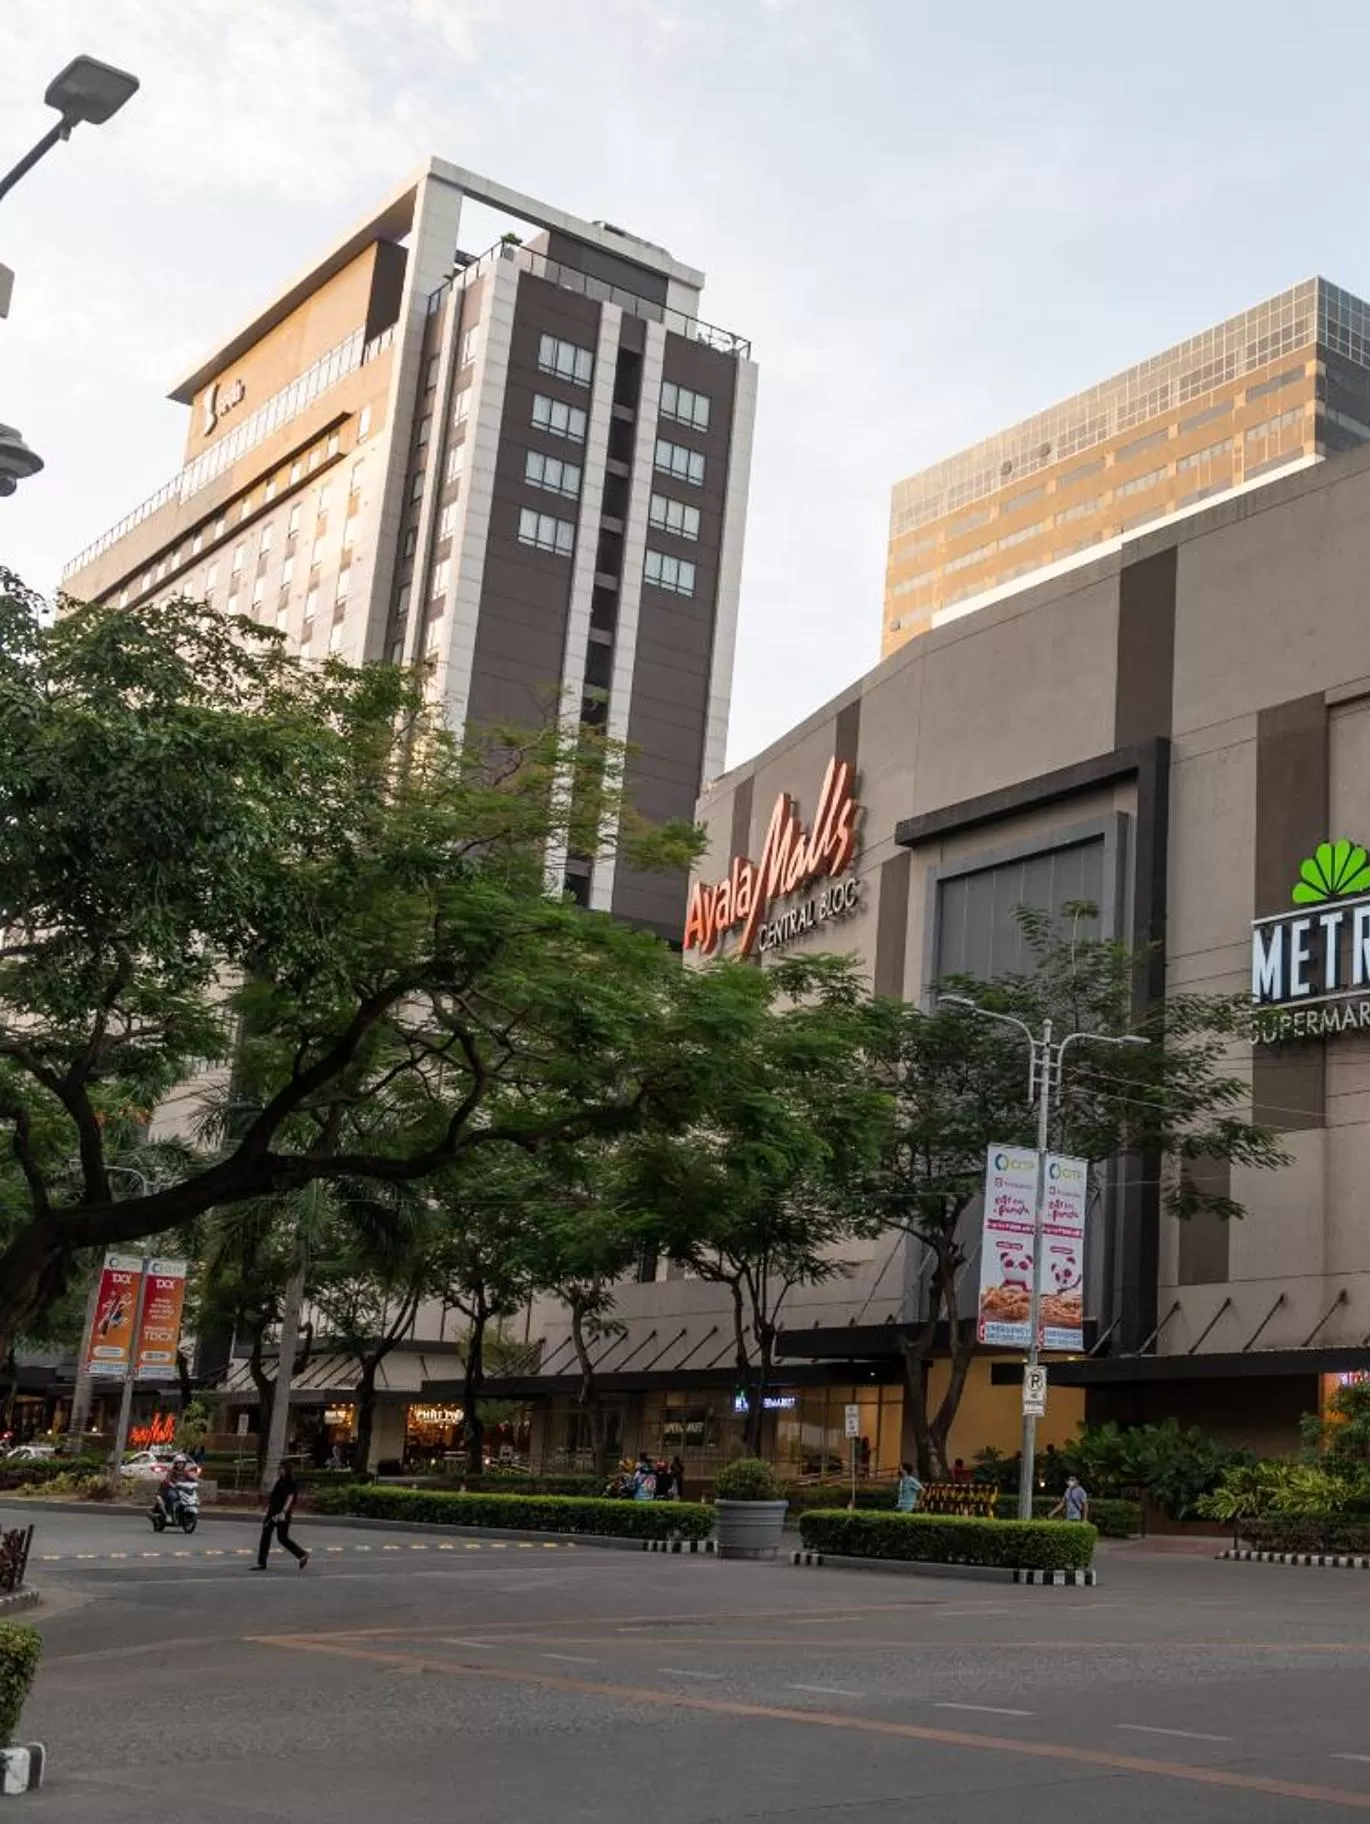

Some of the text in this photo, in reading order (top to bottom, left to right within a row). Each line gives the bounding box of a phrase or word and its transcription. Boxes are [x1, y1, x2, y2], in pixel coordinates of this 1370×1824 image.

[684, 755, 857, 961] Ayala Malls
[759, 877, 861, 950] CENTRAL BLOC
